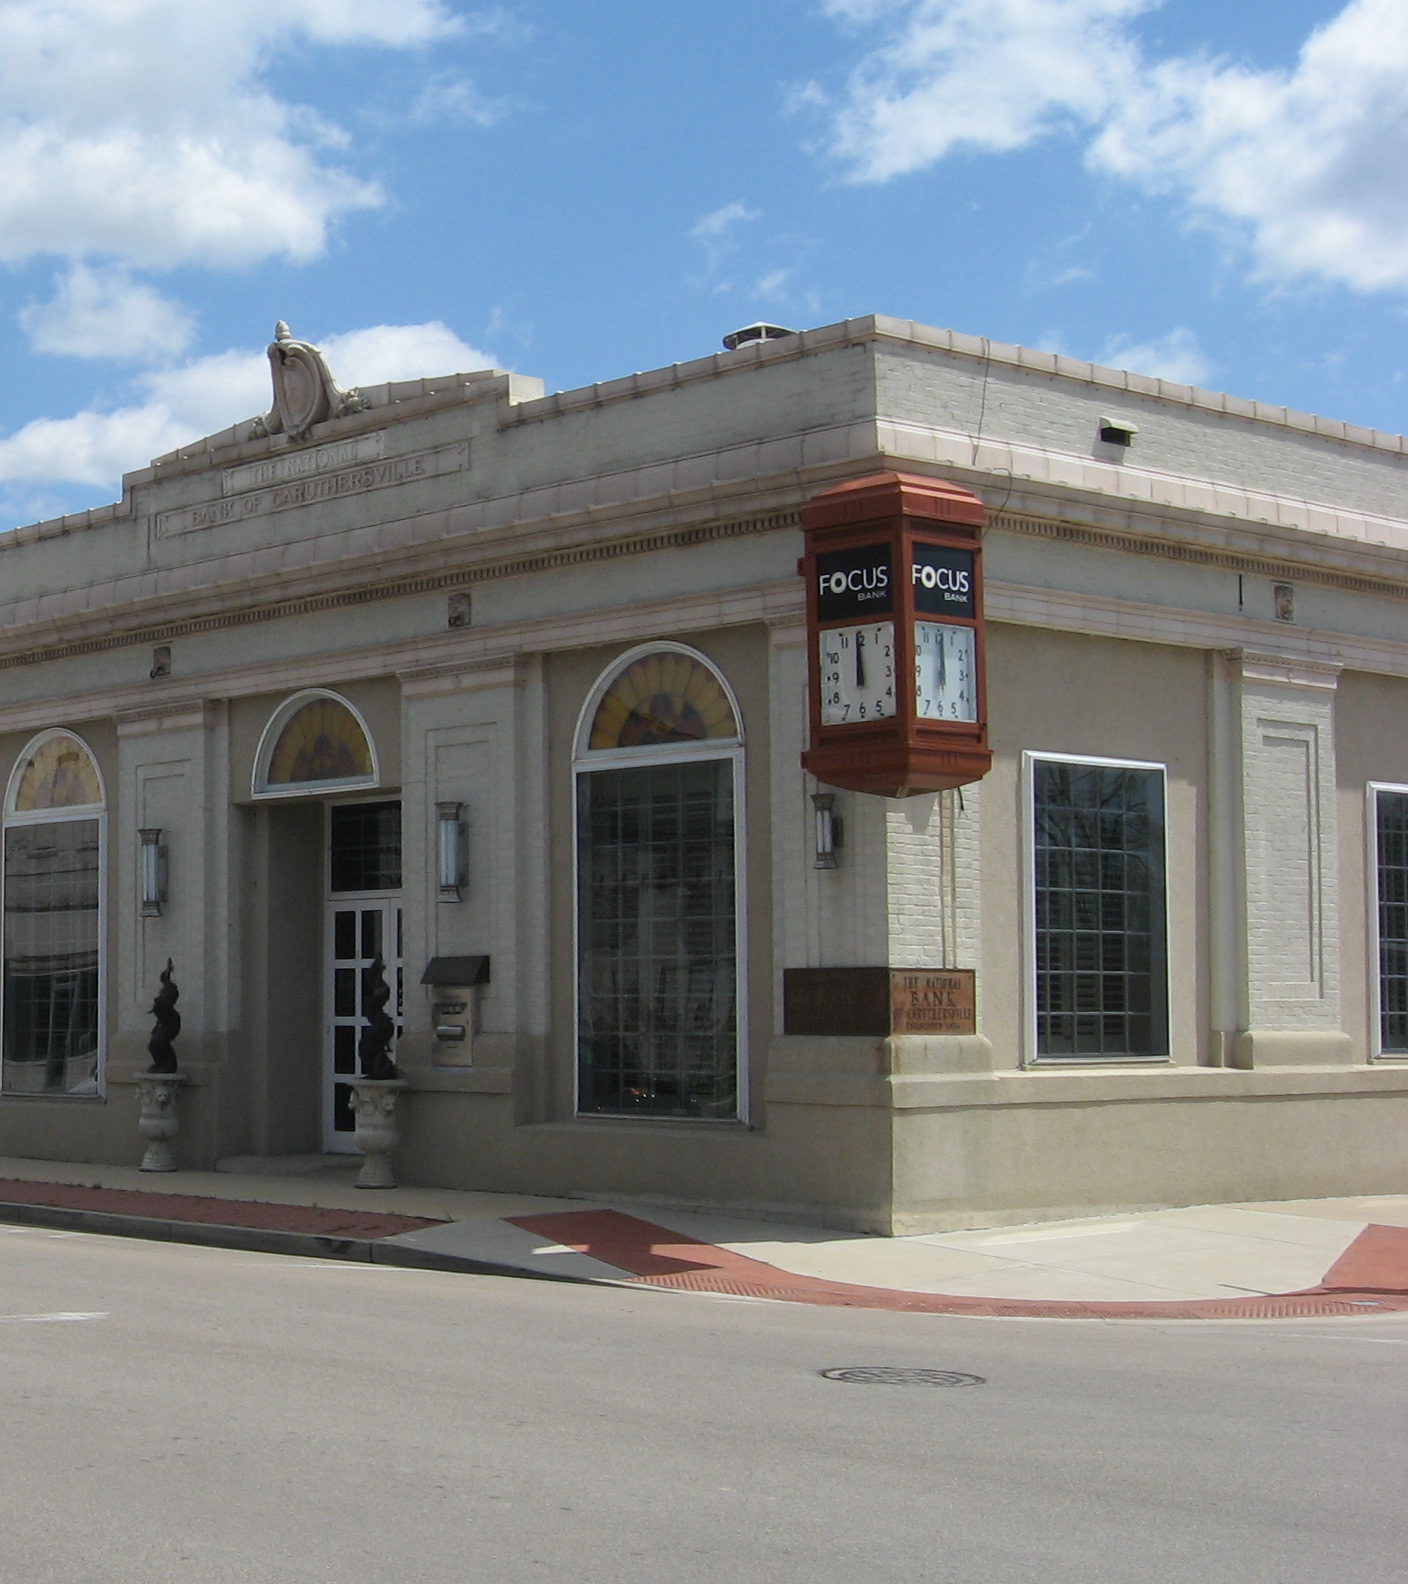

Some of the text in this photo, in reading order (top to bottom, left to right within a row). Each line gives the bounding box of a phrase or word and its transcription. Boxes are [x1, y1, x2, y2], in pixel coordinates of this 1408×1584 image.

[192, 459, 425, 526] BANK OF CARUTHERSVILLE
[819, 566, 888, 595] FOCUS
[912, 564, 969, 592] FOCUS
[857, 590, 887, 601] BANK
[944, 593, 968, 603] BANK
[884, 645, 891, 657] 2
[958, 650, 964, 661] 2
[885, 666, 891, 677] 3
[959, 670, 964, 681] 3
[833, 672, 839, 684] 9
[886, 686, 892, 697] 4
[833, 692, 840, 704] 8
[844, 704, 851, 716] 7
[859, 702, 866, 714] 6
[876, 701, 882, 712] 5
[925, 699, 931, 712] 7
[938, 701, 944, 713] 6
[951, 702, 957, 714] 5
[911, 991, 956, 1007] BANK
